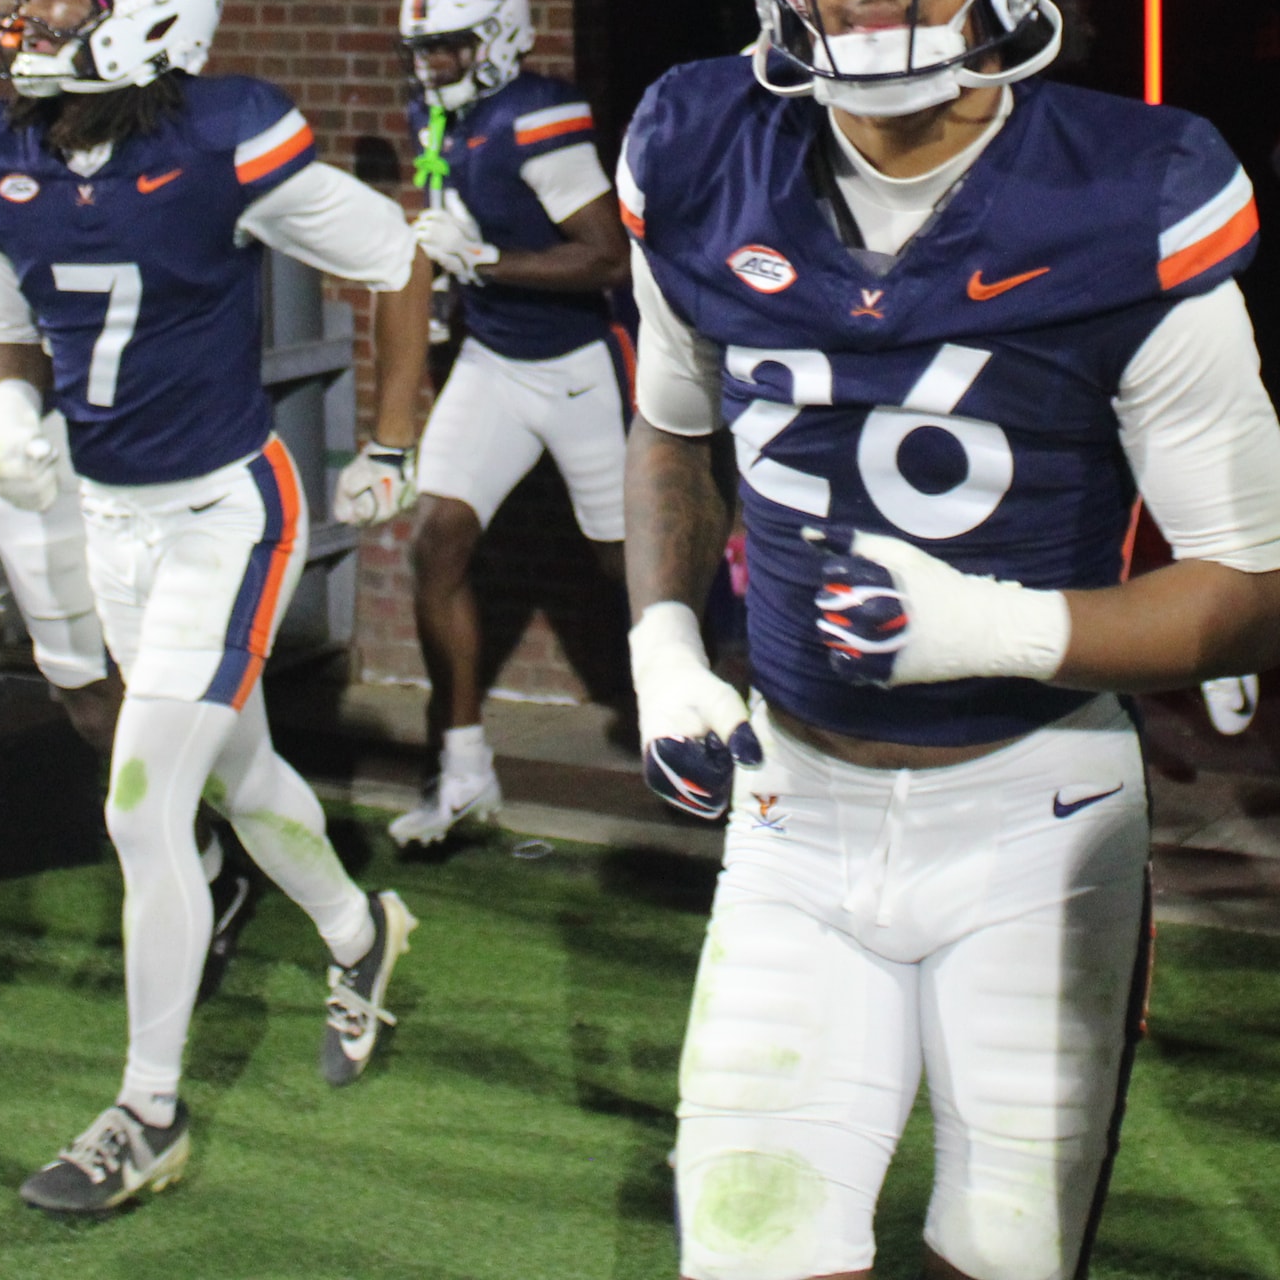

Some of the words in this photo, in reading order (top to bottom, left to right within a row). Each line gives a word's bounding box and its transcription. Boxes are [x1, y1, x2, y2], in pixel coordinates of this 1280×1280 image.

[50, 263, 142, 408] 7
[738, 257, 791, 282] ACC
[725, 342, 1014, 540] 26
